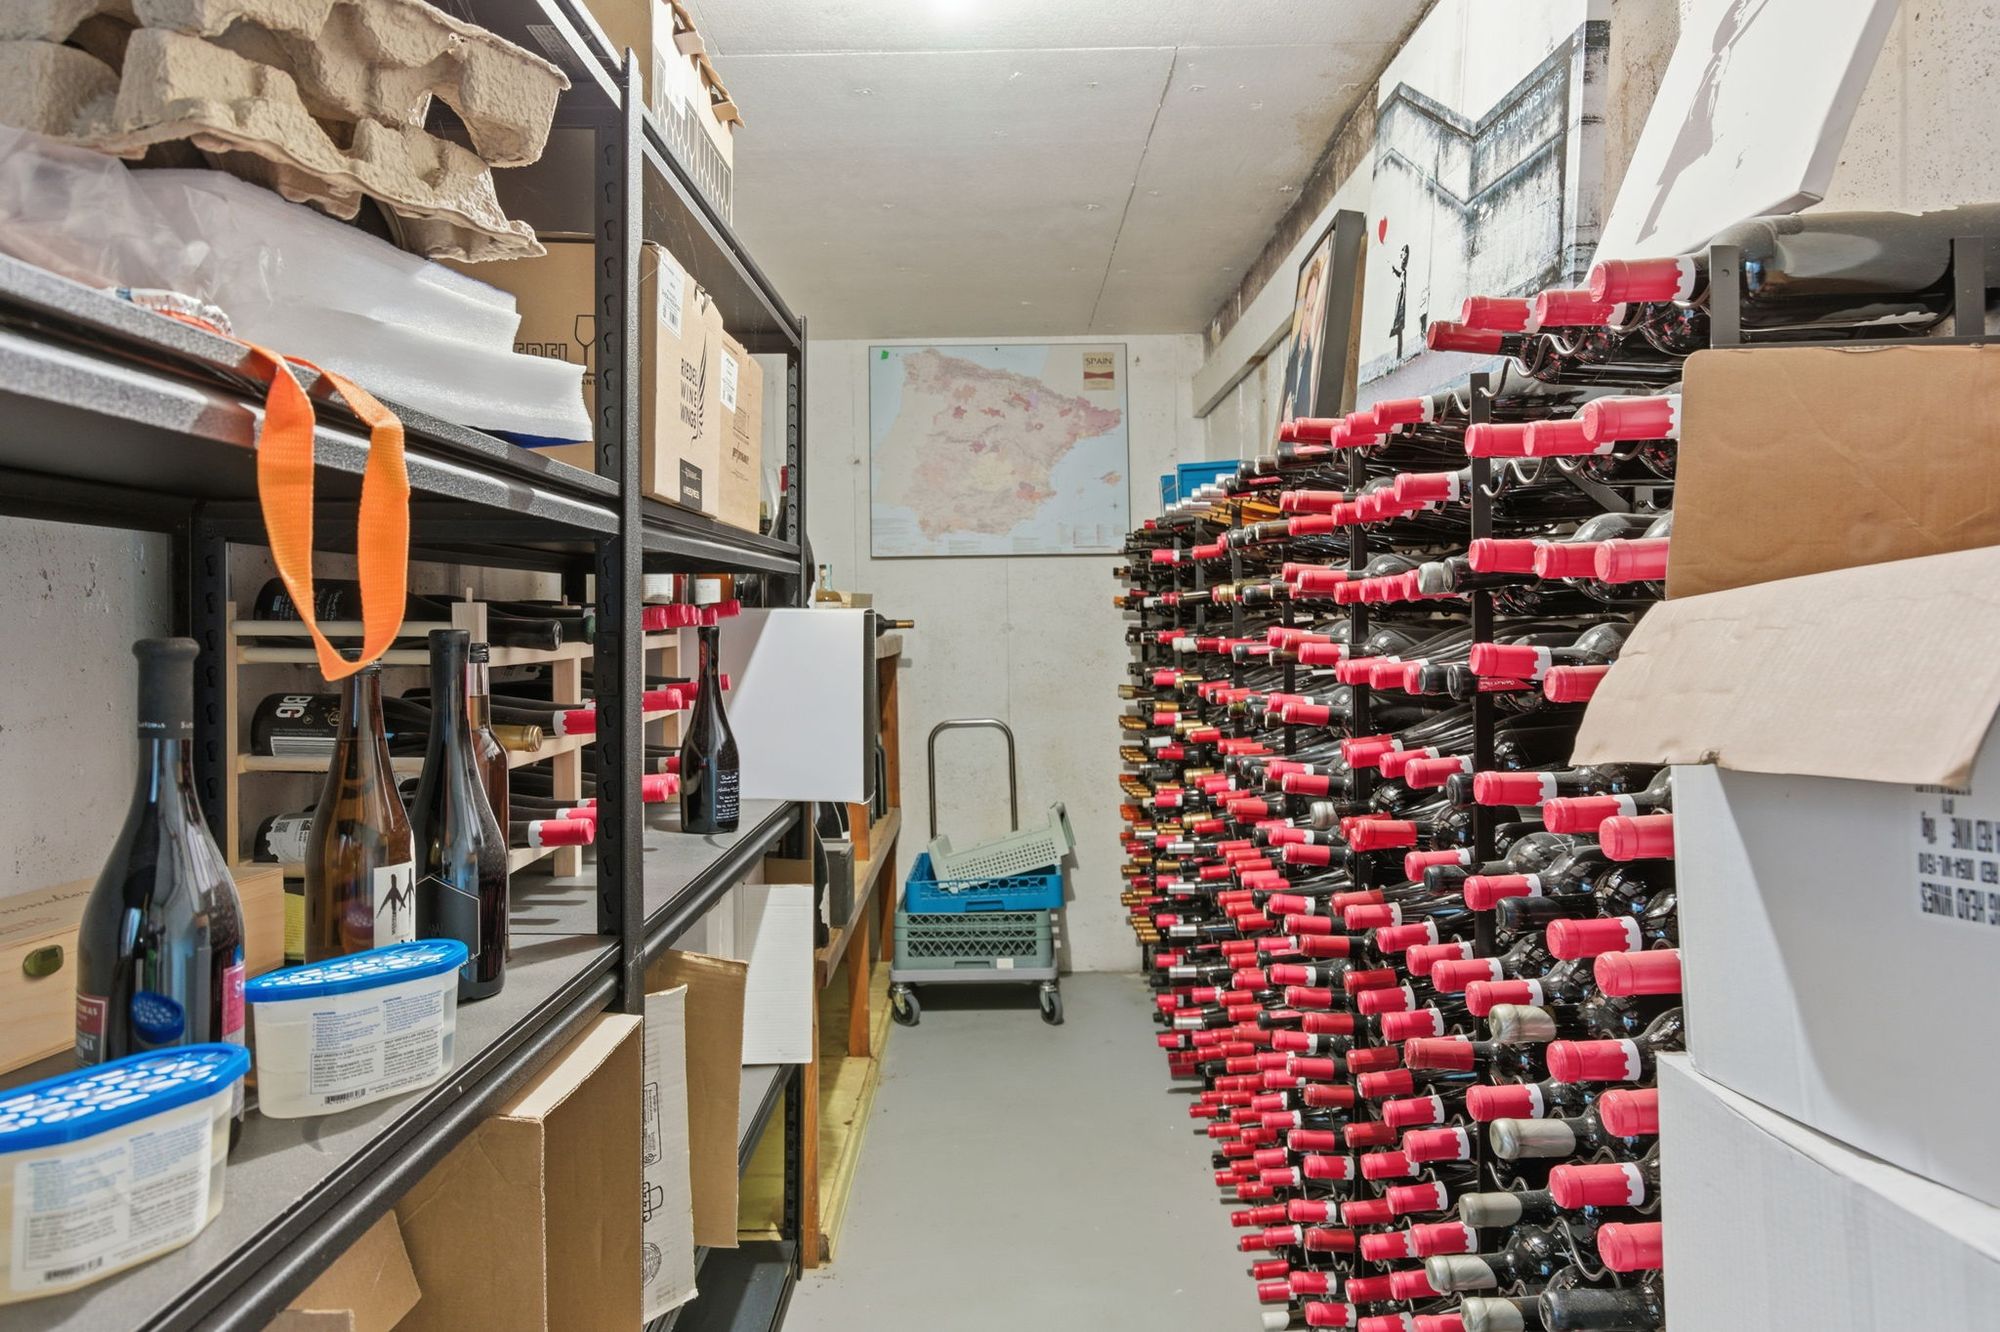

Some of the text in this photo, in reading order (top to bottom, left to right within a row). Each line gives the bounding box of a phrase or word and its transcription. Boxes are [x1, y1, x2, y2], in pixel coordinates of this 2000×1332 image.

[1542, 66, 1565, 97] HOPE
[681, 358, 698, 386] RIEDEL
[1086, 357, 1112, 365] SPAIN
[680, 380, 697, 408] WINE
[680, 402, 697, 429] WINGS
[276, 695, 313, 718] BIG
